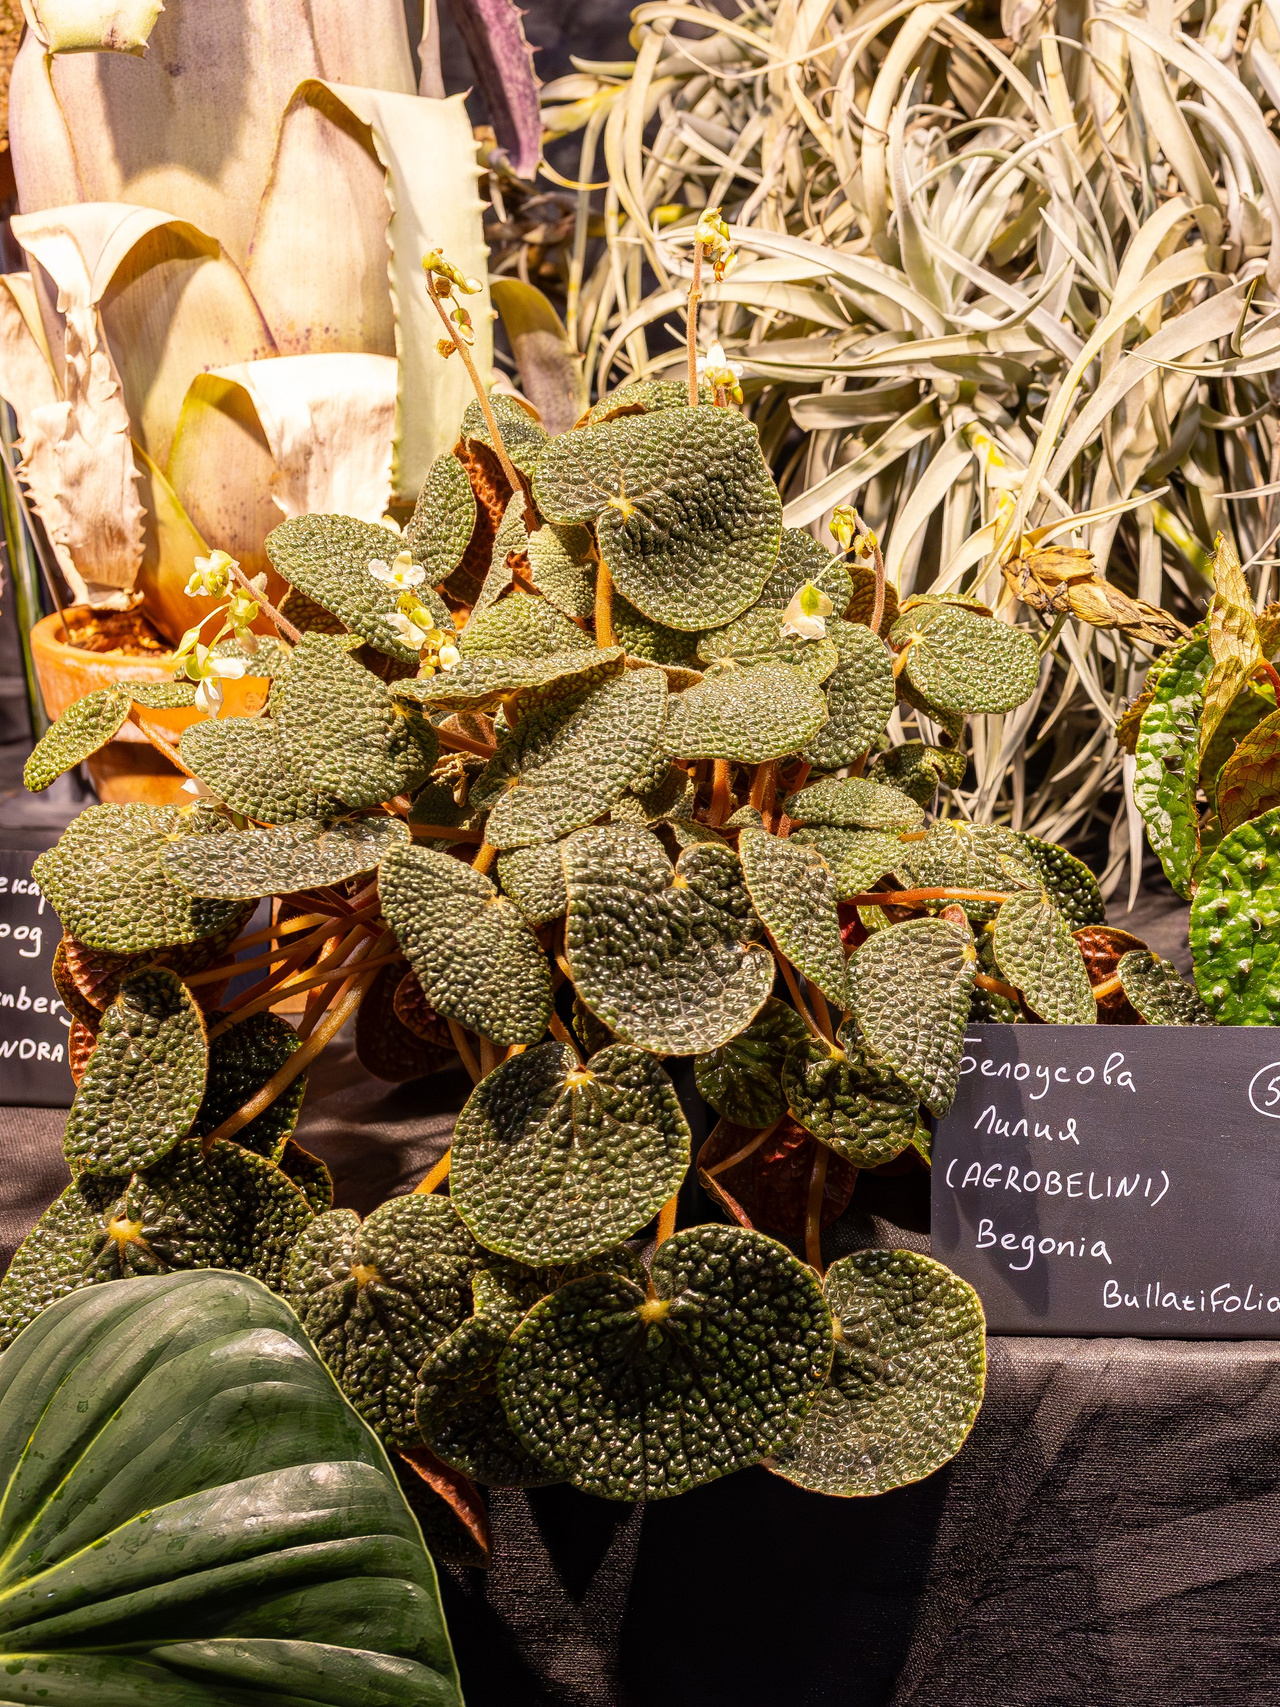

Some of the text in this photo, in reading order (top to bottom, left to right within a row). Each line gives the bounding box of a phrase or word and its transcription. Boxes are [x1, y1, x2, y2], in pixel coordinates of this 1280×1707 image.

[974, 1104, 1080, 1145] Лилия
[945, 1158, 1170, 1207] (AGROBELINI)
[975, 1218, 1112, 1271] Begonia
